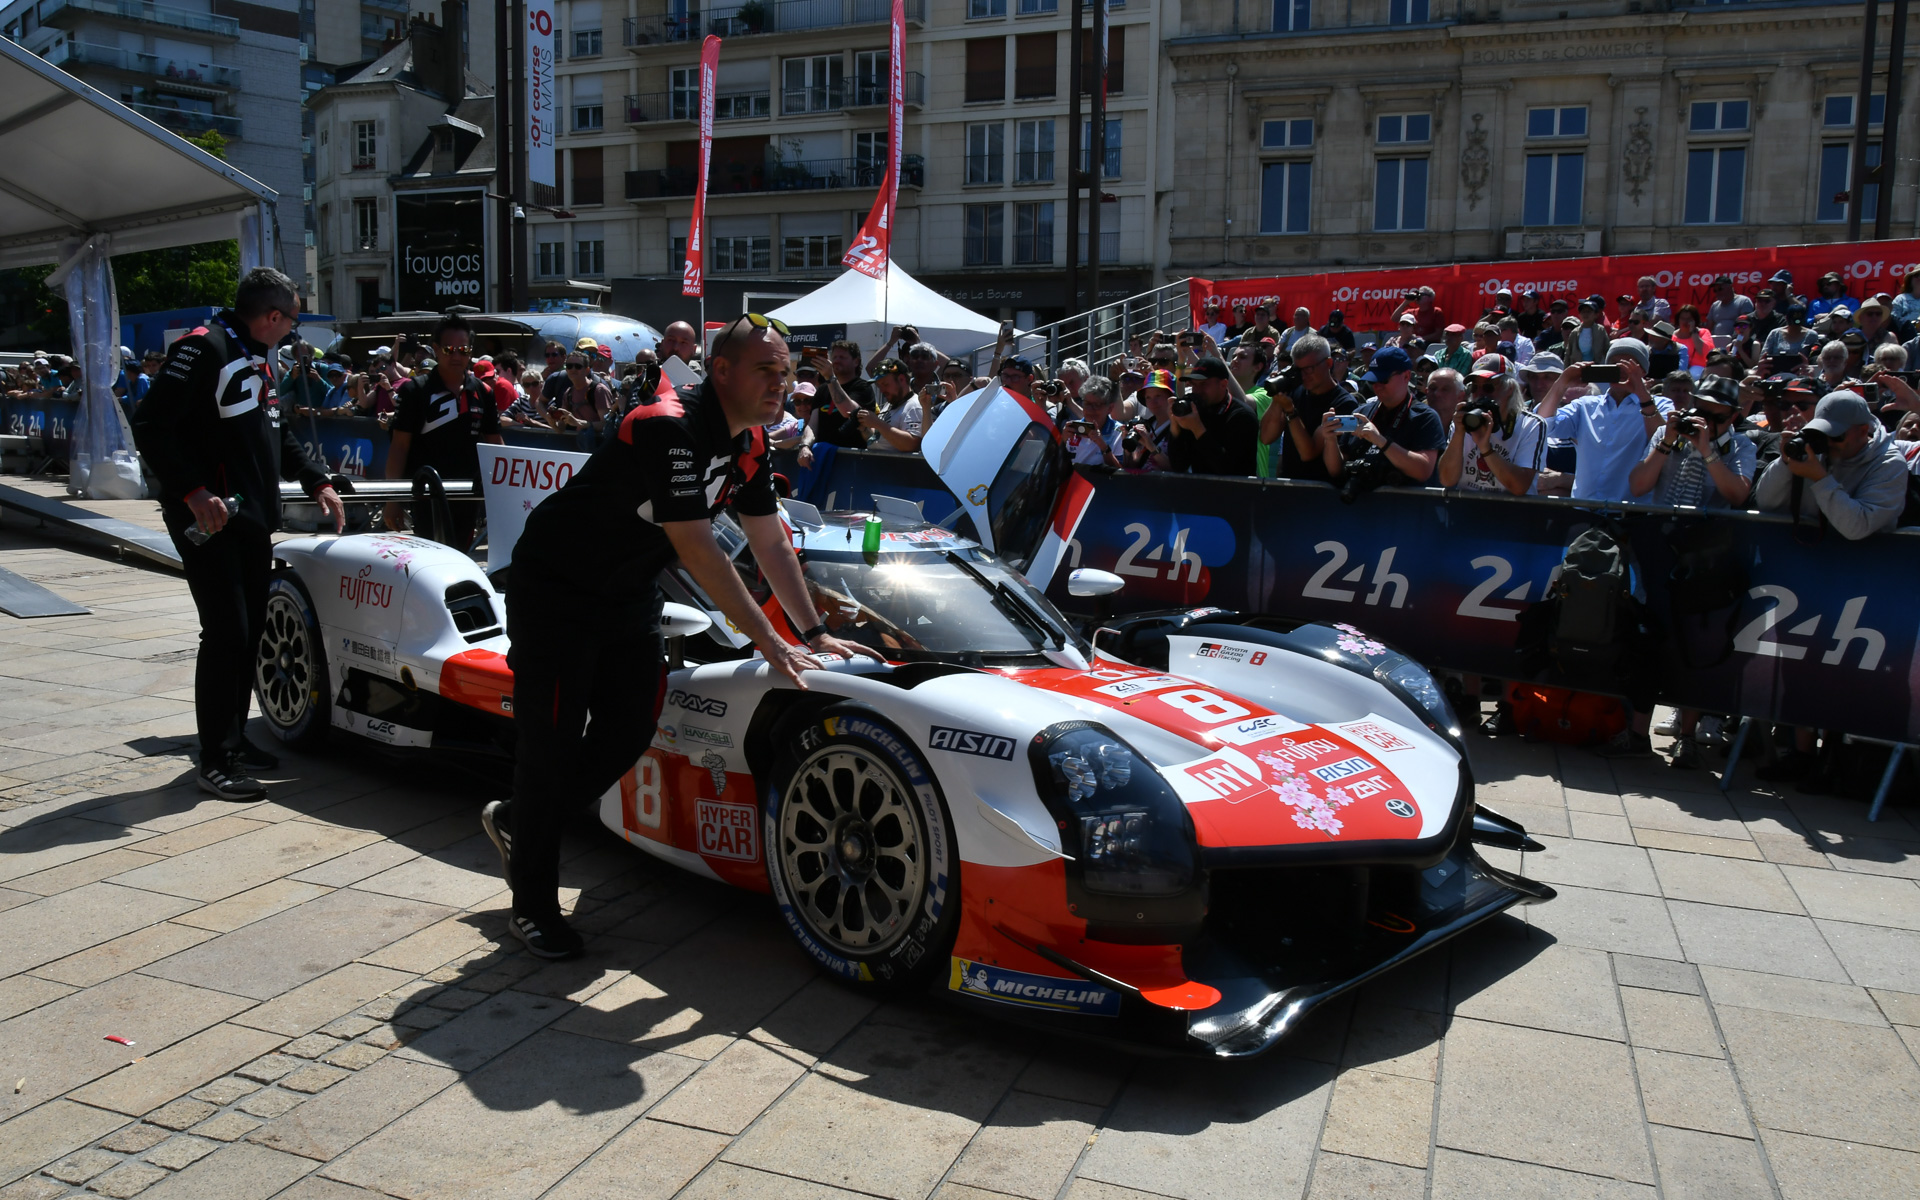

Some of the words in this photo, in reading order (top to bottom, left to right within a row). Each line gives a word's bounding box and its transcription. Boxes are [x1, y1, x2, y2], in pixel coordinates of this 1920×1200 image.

[1473, 48, 1536, 64] BOURSE
[1564, 41, 1654, 60] COMMERCE
[532, 45, 541, 112] course
[541, 48, 553, 112] MANS
[541, 121, 553, 147] LE
[405, 246, 481, 278] faugas
[842, 255, 858, 266] LE
[435, 278, 481, 296] PHOTO
[955, 291, 967, 300] de
[971, 289, 983, 300] La
[986, 289, 1023, 300] Bourse
[1514, 279, 1579, 293] course
[792, 333, 819, 343] OFFICIEL
[52, 417, 67, 439] 24h
[340, 444, 364, 476] 24h
[671, 461, 695, 470] ZENT
[491, 456, 574, 491] DENSO
[1115, 522, 1201, 584] 24h
[1302, 540, 1409, 609] 24h
[339, 575, 394, 610] FUJITSU
[1732, 584, 1887, 671] 24h
[1198, 647, 1218, 659] GR
[1222, 645, 1249, 653] TOYOTA
[1220, 650, 1244, 658] GAZOO
[1249, 651, 1268, 666] 8
[668, 689, 728, 717] RAYS
[1157, 688, 1251, 724] 8
[367, 719, 396, 735] WEC
[684, 727, 730, 743] HAYASHI
[799, 725, 822, 750] FR
[1237, 718, 1277, 733] WEC
[1345, 724, 1379, 736] HYPER
[850, 720, 923, 779] MICHELIN
[930, 729, 1013, 758] AISIN
[1273, 738, 1340, 762] FUJITSU
[1363, 732, 1409, 749] CAR
[1193, 763, 1253, 796] HY
[1316, 757, 1372, 781] AISIN
[634, 755, 661, 830] 8
[1344, 775, 1393, 800] ZENT
[699, 804, 751, 828] HYPER
[923, 792, 937, 826] PILOT
[932, 826, 942, 864] SPORT
[701, 822, 753, 856] CAR
[785, 911, 845, 973] MICHELIN
[993, 978, 1106, 1005] MICHELIN
